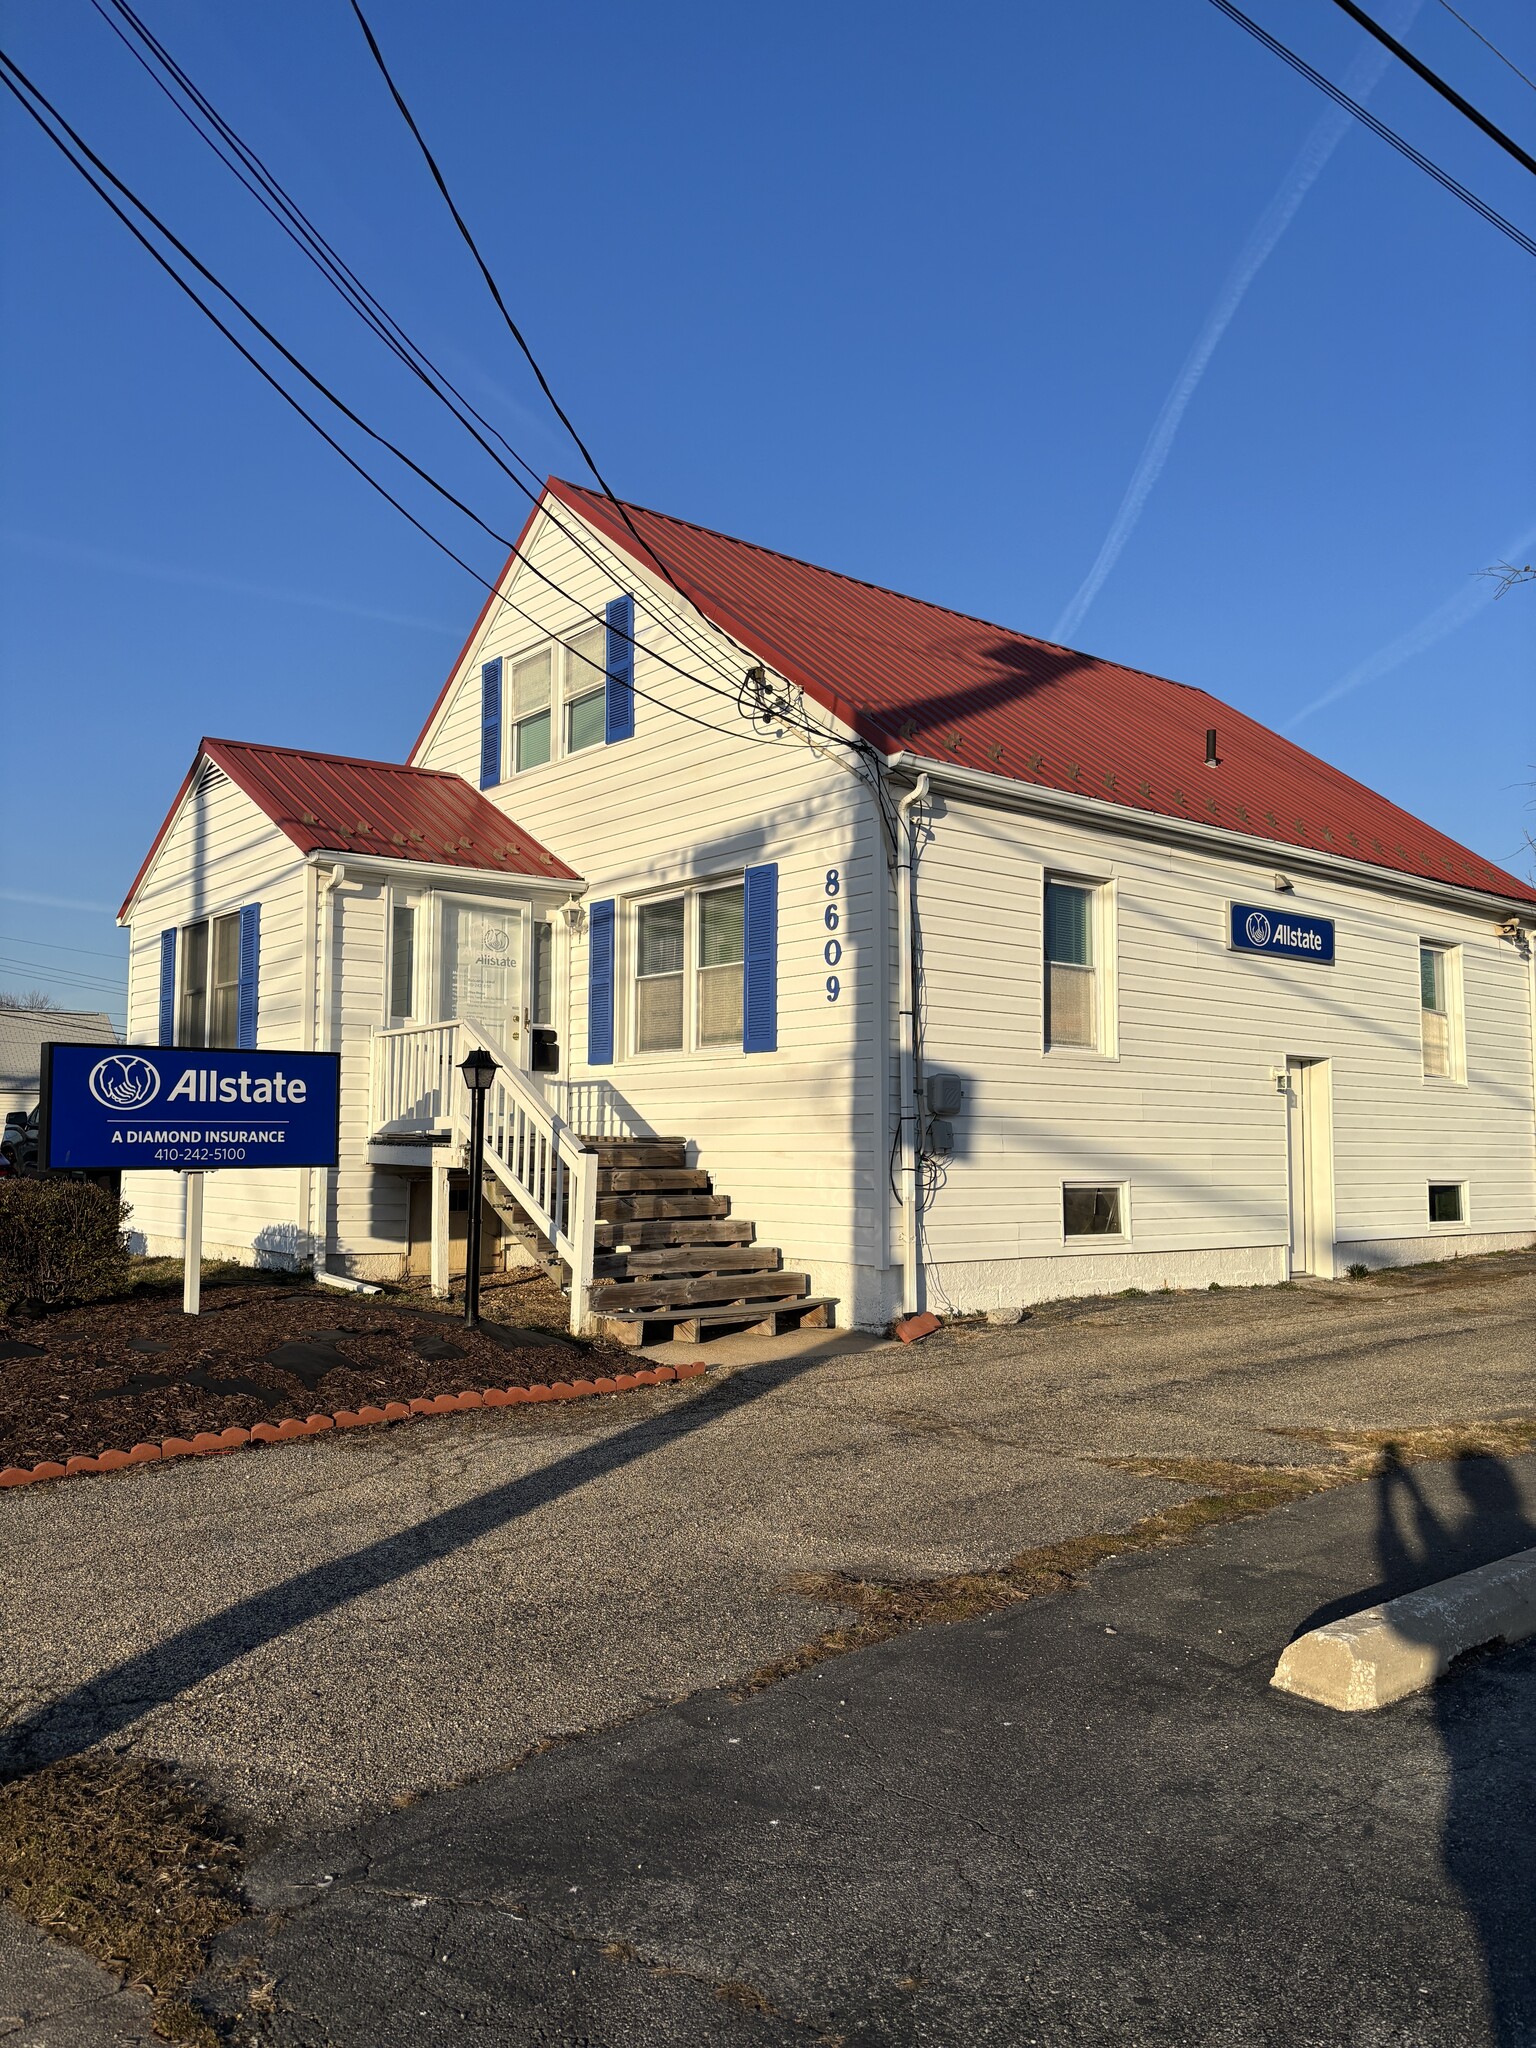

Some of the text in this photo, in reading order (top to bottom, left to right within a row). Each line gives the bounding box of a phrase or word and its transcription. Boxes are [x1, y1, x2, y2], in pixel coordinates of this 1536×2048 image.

[824, 869, 842, 1002] 8609
[1273, 924, 1322, 951] Allstate
[475, 954, 517, 968] Allstate
[167, 1069, 307, 1103] Allstate
[111, 1131, 285, 1143] A DIAMOND INSURANCE
[154, 1148, 246, 1161] 410-242-5100
